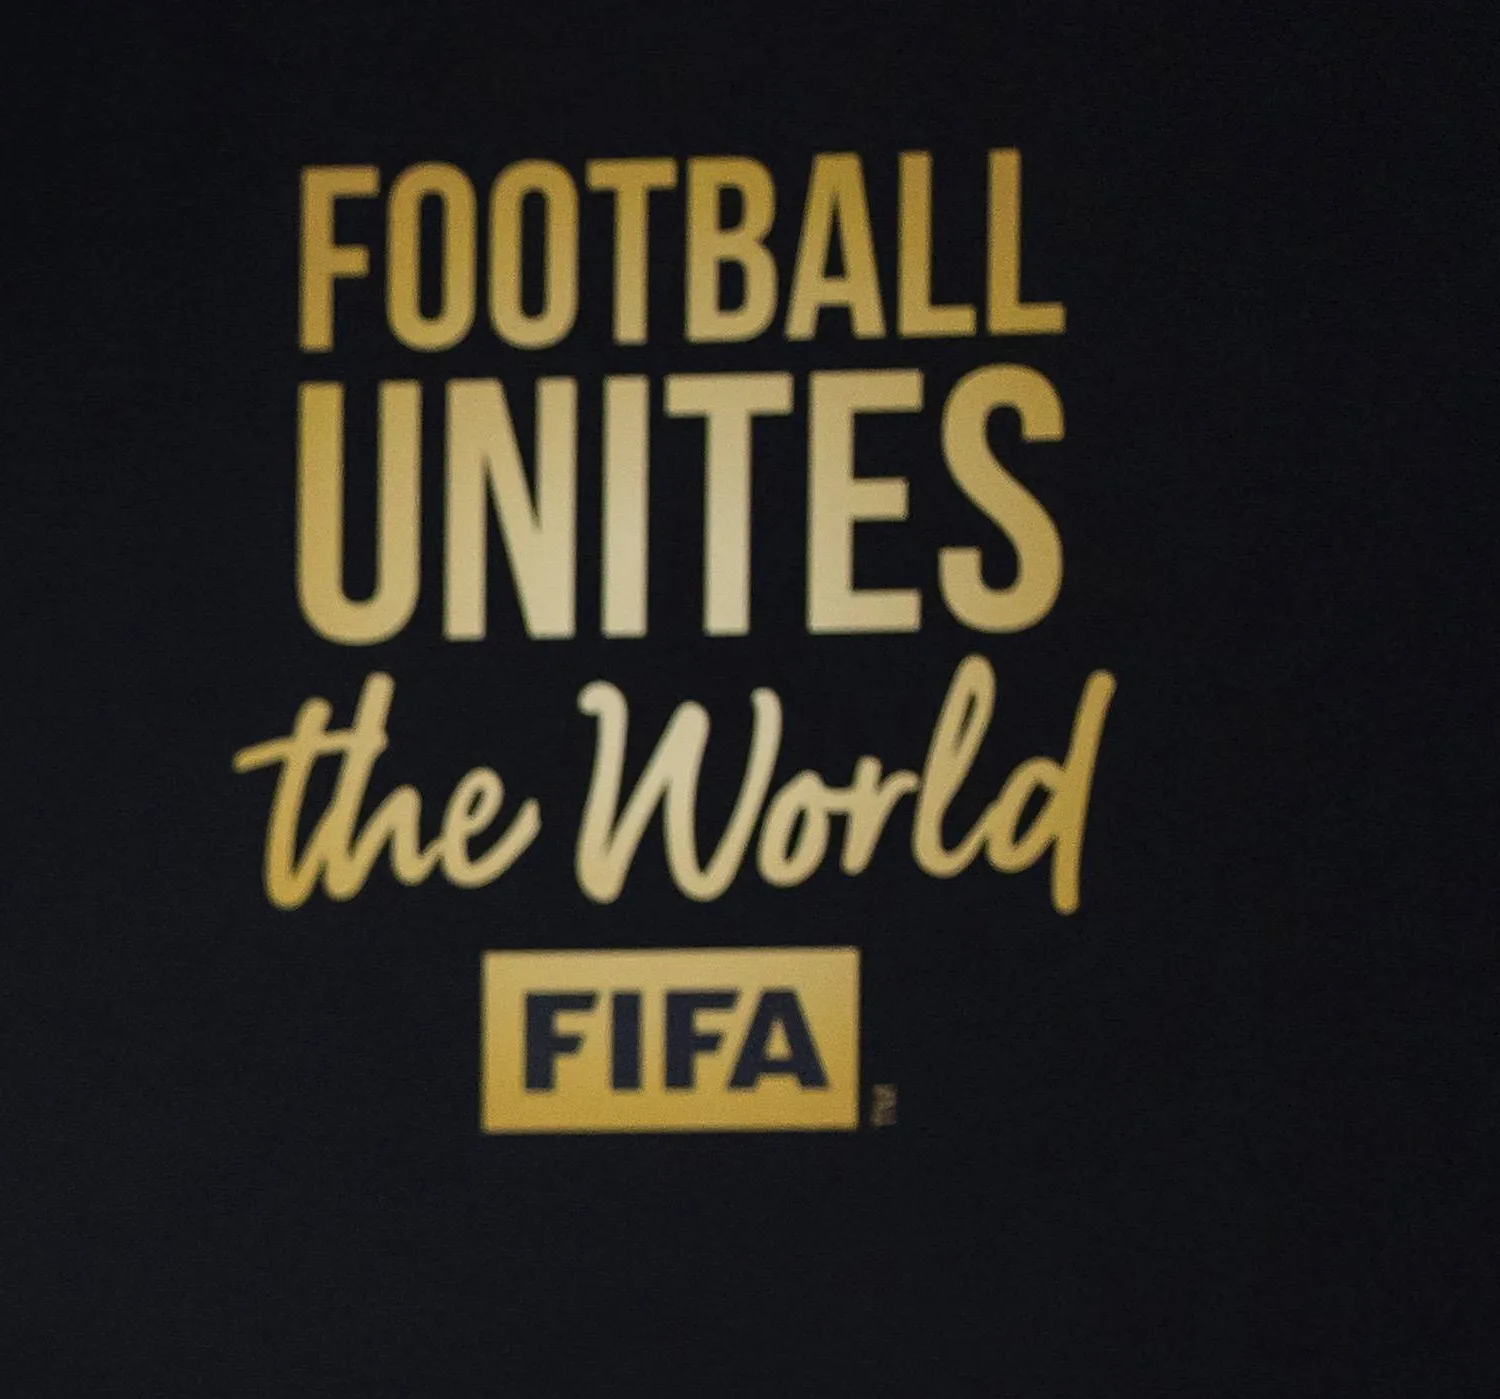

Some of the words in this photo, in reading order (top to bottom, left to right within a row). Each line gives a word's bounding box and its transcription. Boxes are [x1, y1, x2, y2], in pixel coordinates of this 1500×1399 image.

[299, 148, 1066, 352] FOOTBALL
[296, 364, 1065, 646] UNITES
[233, 672, 541, 909] the
[575, 654, 1116, 914] World
[521, 986, 831, 1095] FIFA
